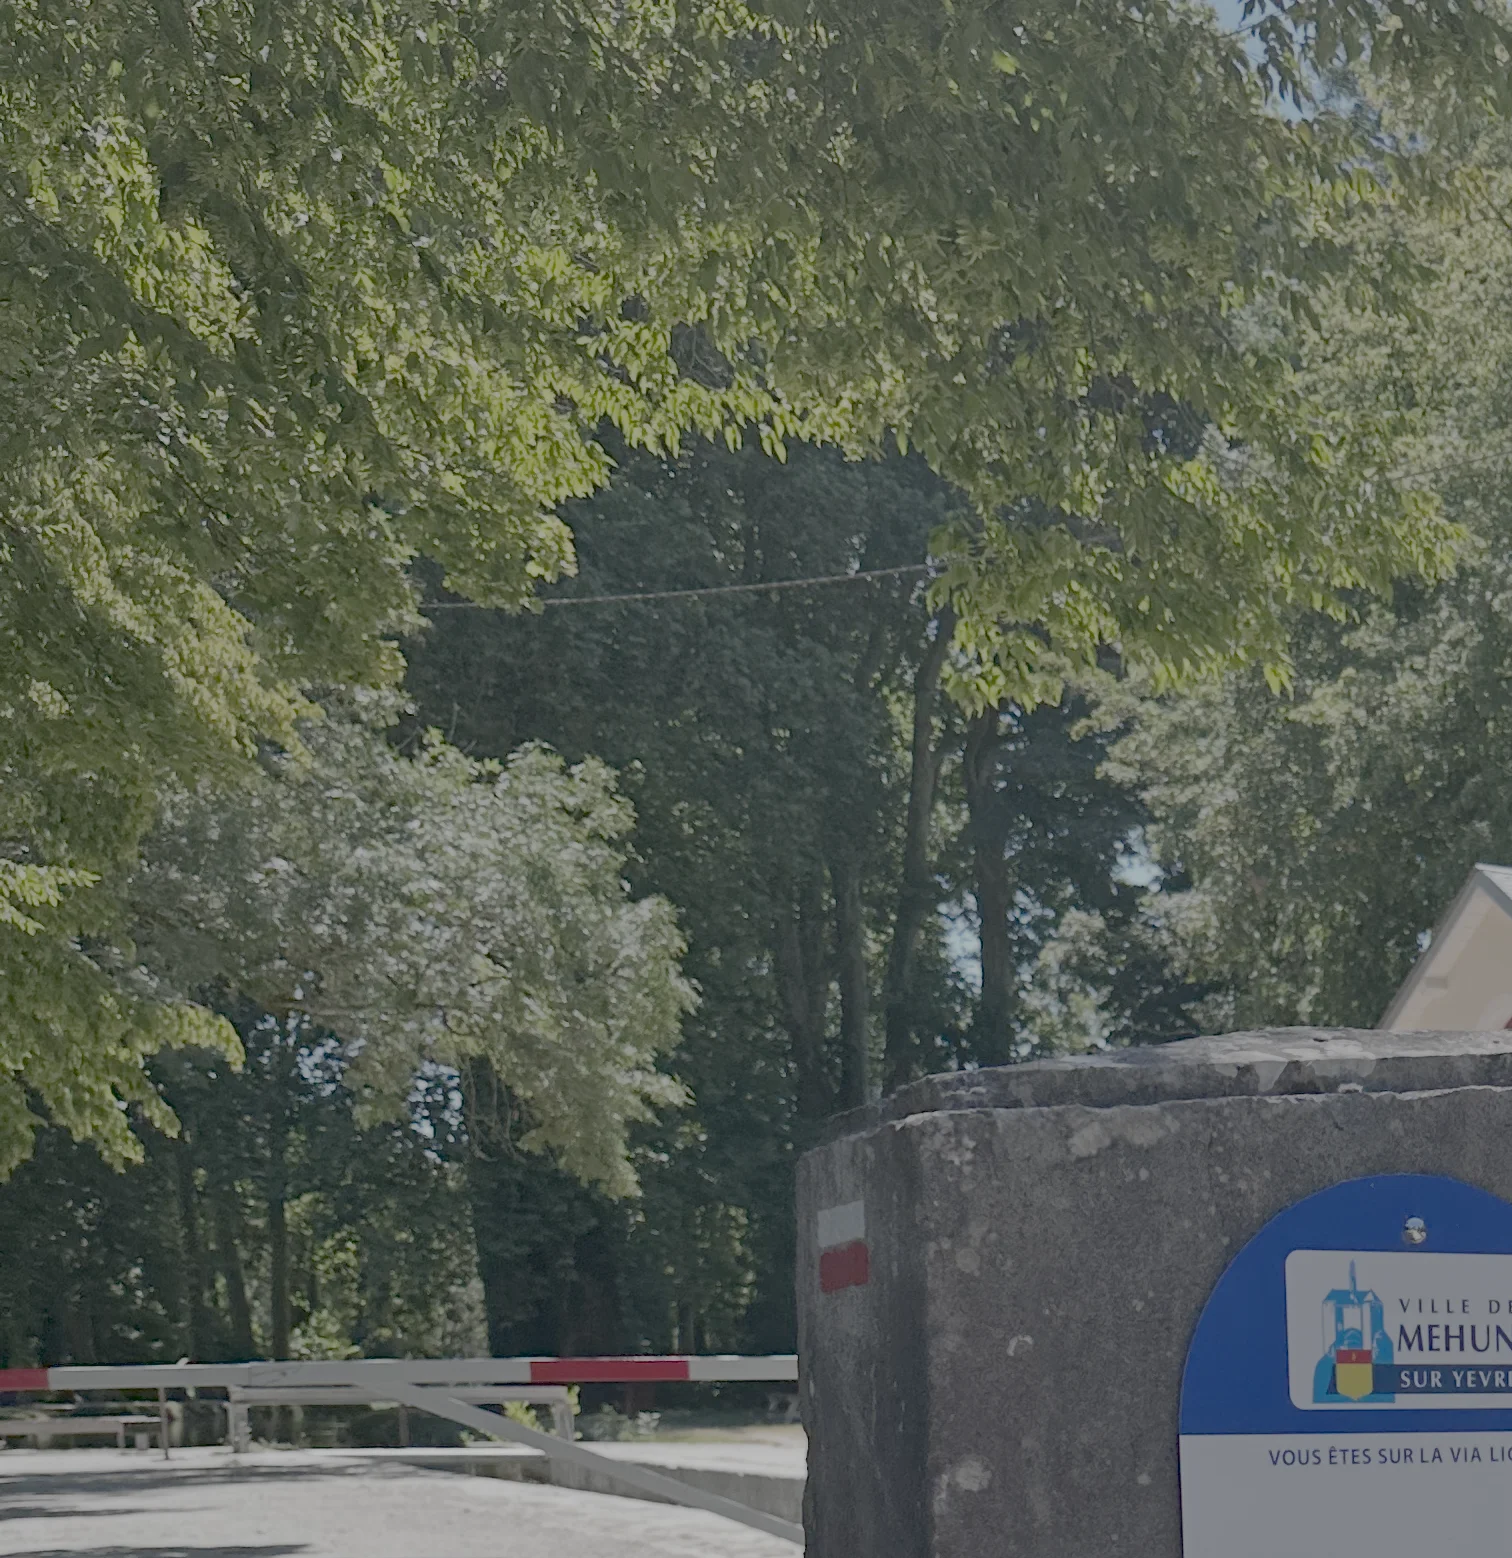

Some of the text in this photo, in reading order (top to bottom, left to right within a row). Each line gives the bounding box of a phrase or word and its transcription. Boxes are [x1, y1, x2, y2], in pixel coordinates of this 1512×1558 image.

[1398, 1298, 1470, 1314] VILLE
[1400, 1370, 1443, 1388] SUR
[1269, 1449, 1322, 1466] VOUS
[1328, 1446, 1372, 1465] ÊTES
[1378, 1448, 1414, 1464] SUR
[1420, 1447, 1443, 1464] LA
[1449, 1446, 1482, 1463] VIA
